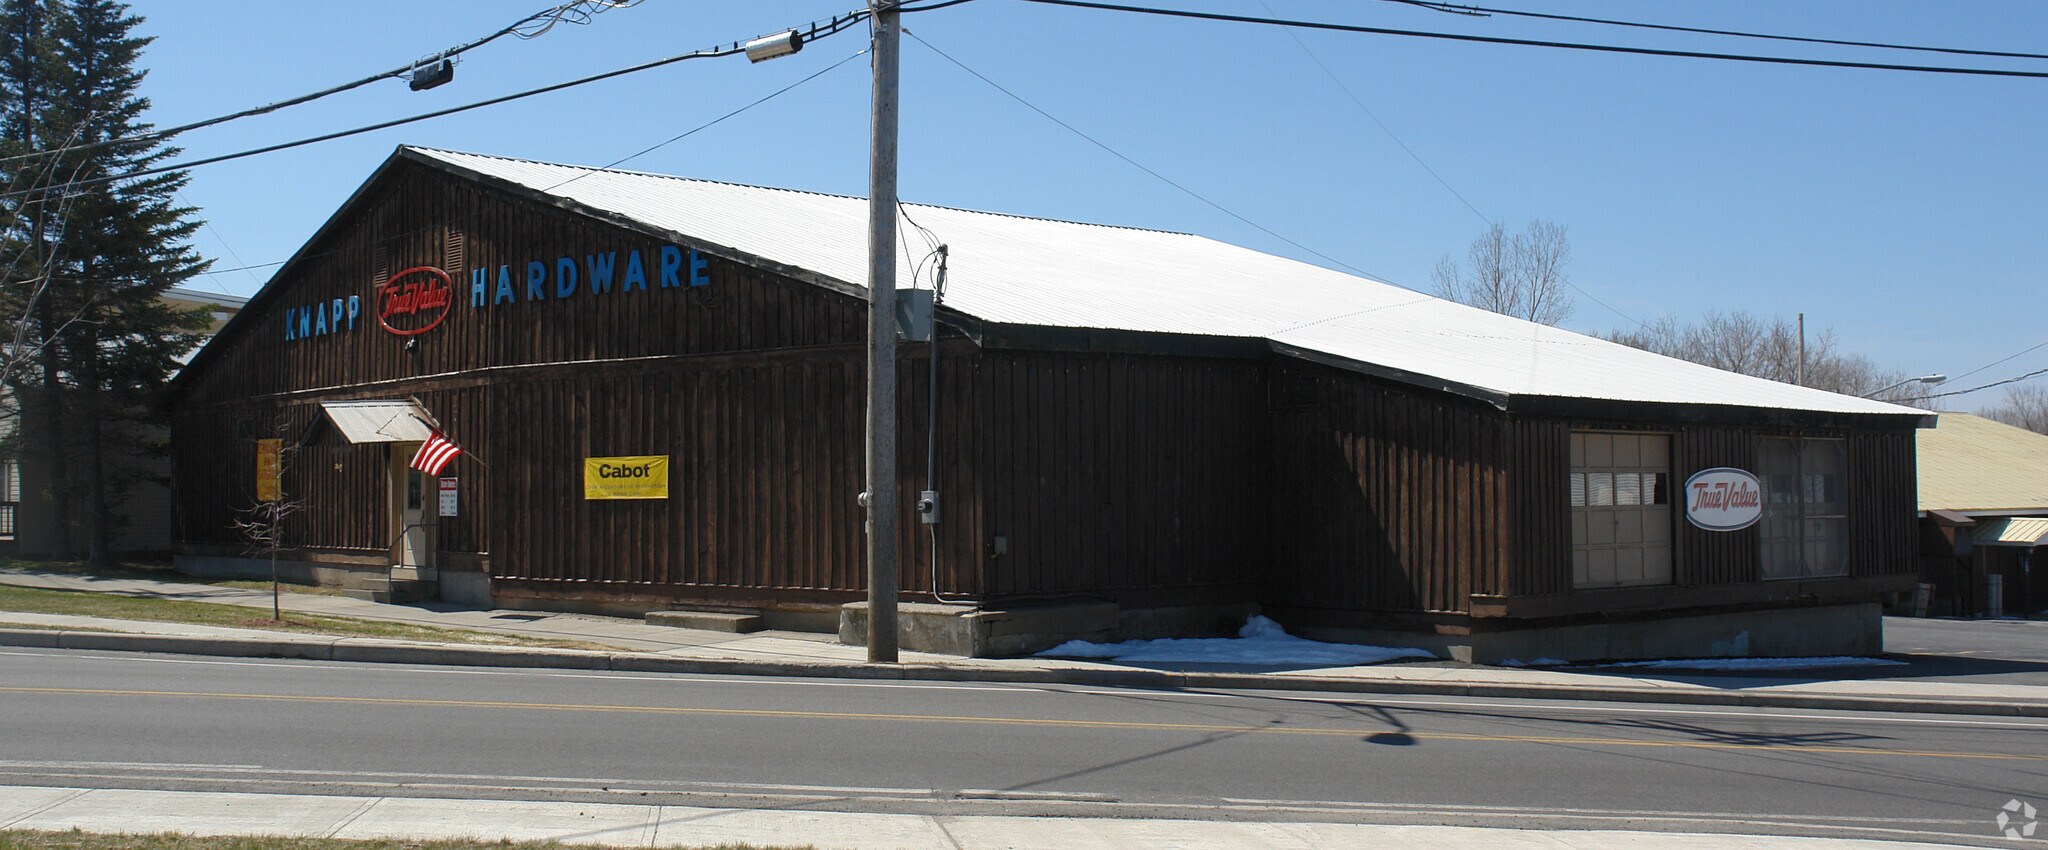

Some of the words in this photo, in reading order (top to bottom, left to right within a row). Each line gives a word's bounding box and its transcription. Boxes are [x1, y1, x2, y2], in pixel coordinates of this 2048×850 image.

[285, 295, 360, 341] KNAPP
[471, 245, 710, 308] HARDWARE
[598, 463, 650, 479] Cabot
